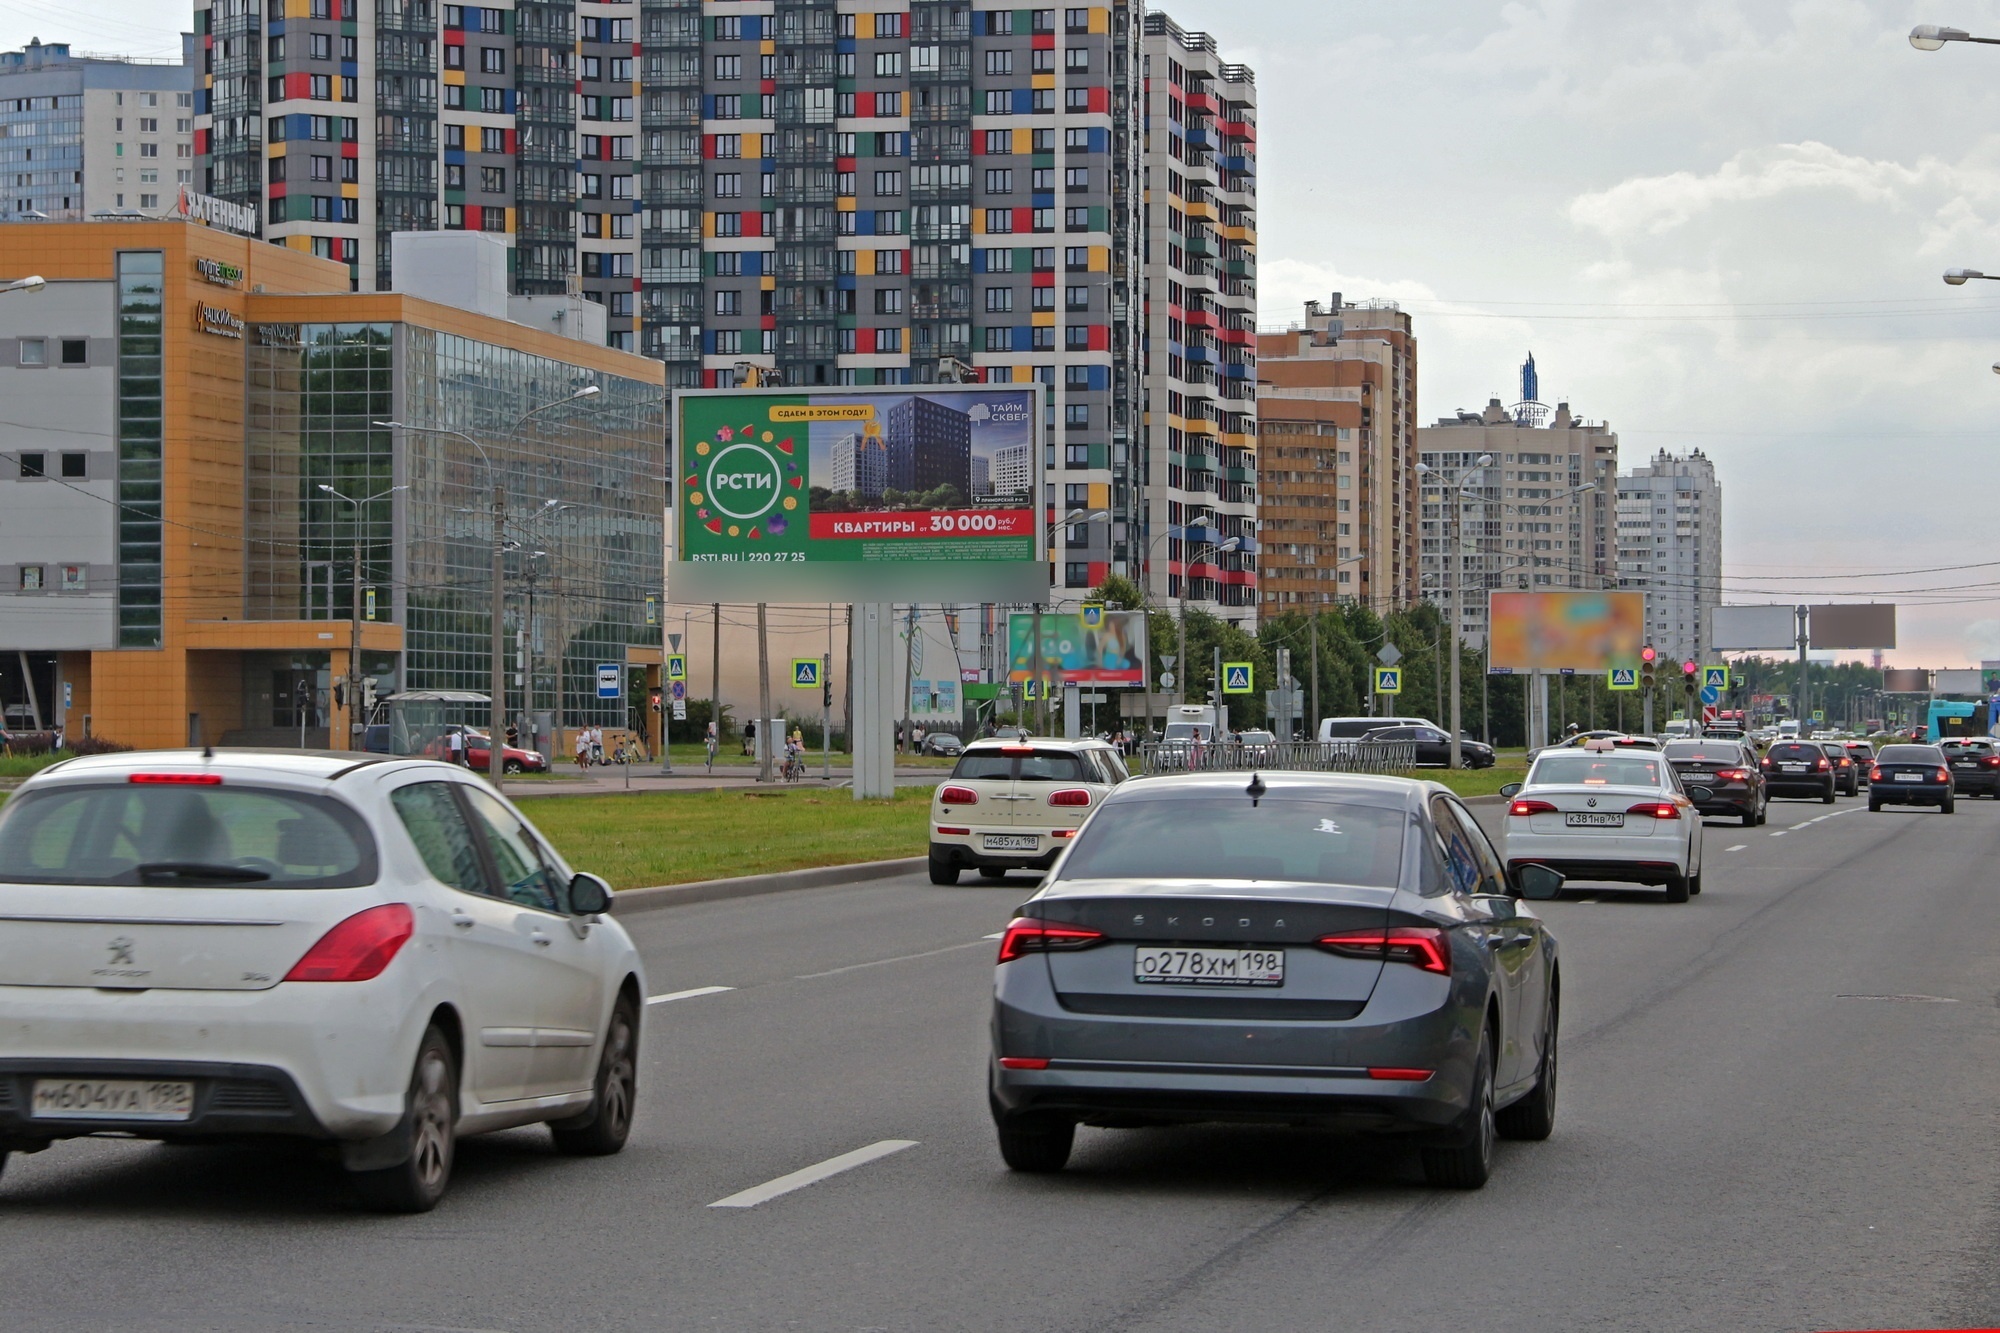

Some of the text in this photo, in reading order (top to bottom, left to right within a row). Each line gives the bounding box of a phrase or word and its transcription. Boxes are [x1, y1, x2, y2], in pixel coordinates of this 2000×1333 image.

[187, 191, 256, 234] ЯХТЕННЫЙ
[991, 402, 1022, 412] ТАЙМ
[842, 409, 867, 417] ГОДУ!
[991, 413, 1029, 421] СКВЕР
[716, 473, 771, 490] РСТИ
[833, 521, 915, 533] КВАРТИРЫ
[930, 515, 955, 532] 30
[958, 514, 996, 531] 000
[749, 552, 771, 561] 220
[774, 552, 787, 561] 27
[791, 552, 805, 561] 25
[1569, 813, 1621, 824] К381НВ 761
[986, 837, 1036, 847] М485УА 198
[1143, 952, 1277, 976] О278ХМ 198
